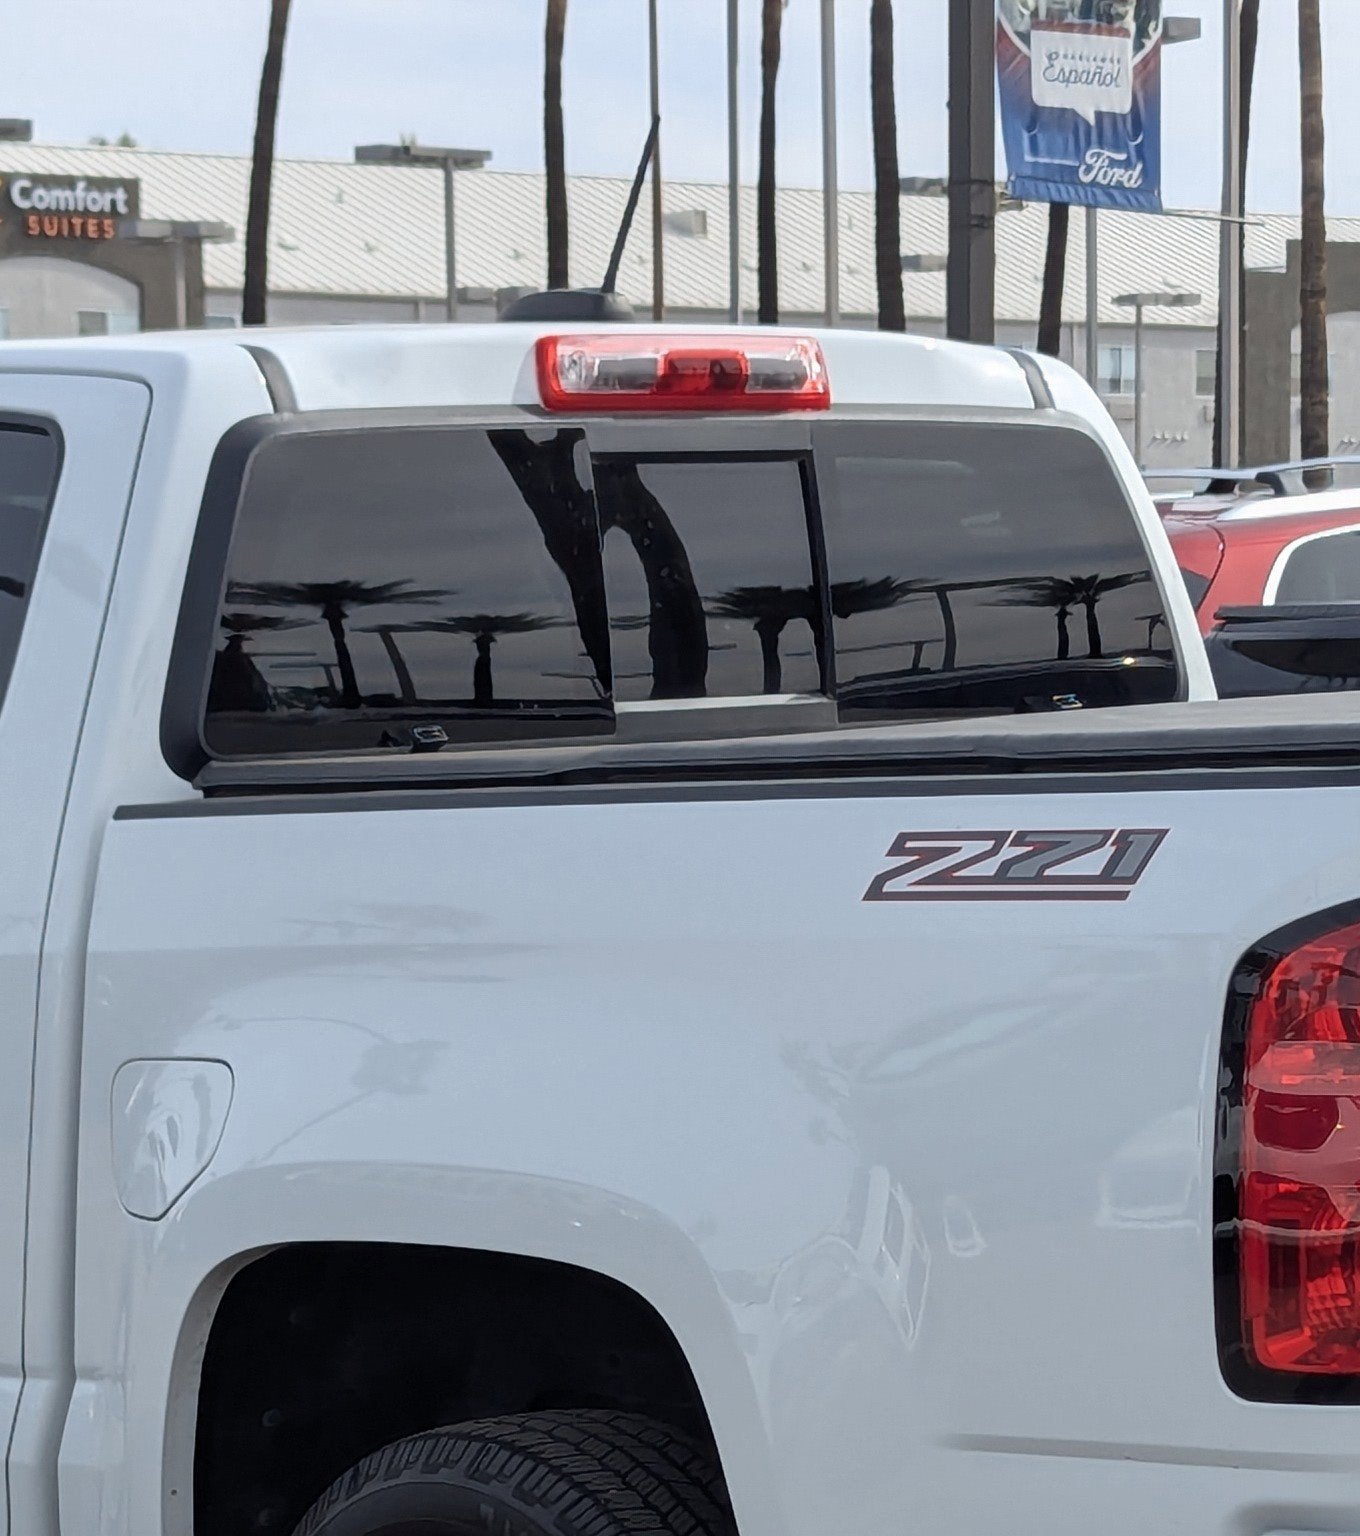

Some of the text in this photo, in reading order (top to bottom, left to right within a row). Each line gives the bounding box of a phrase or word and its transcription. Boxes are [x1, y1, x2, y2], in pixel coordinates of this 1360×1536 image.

[1042, 51, 1122, 88] Español
[1079, 149, 1143, 188] Ford
[10, 178, 129, 214] Comfort
[27, 214, 116, 239] SUITES
[861, 828, 1171, 901] Z71
